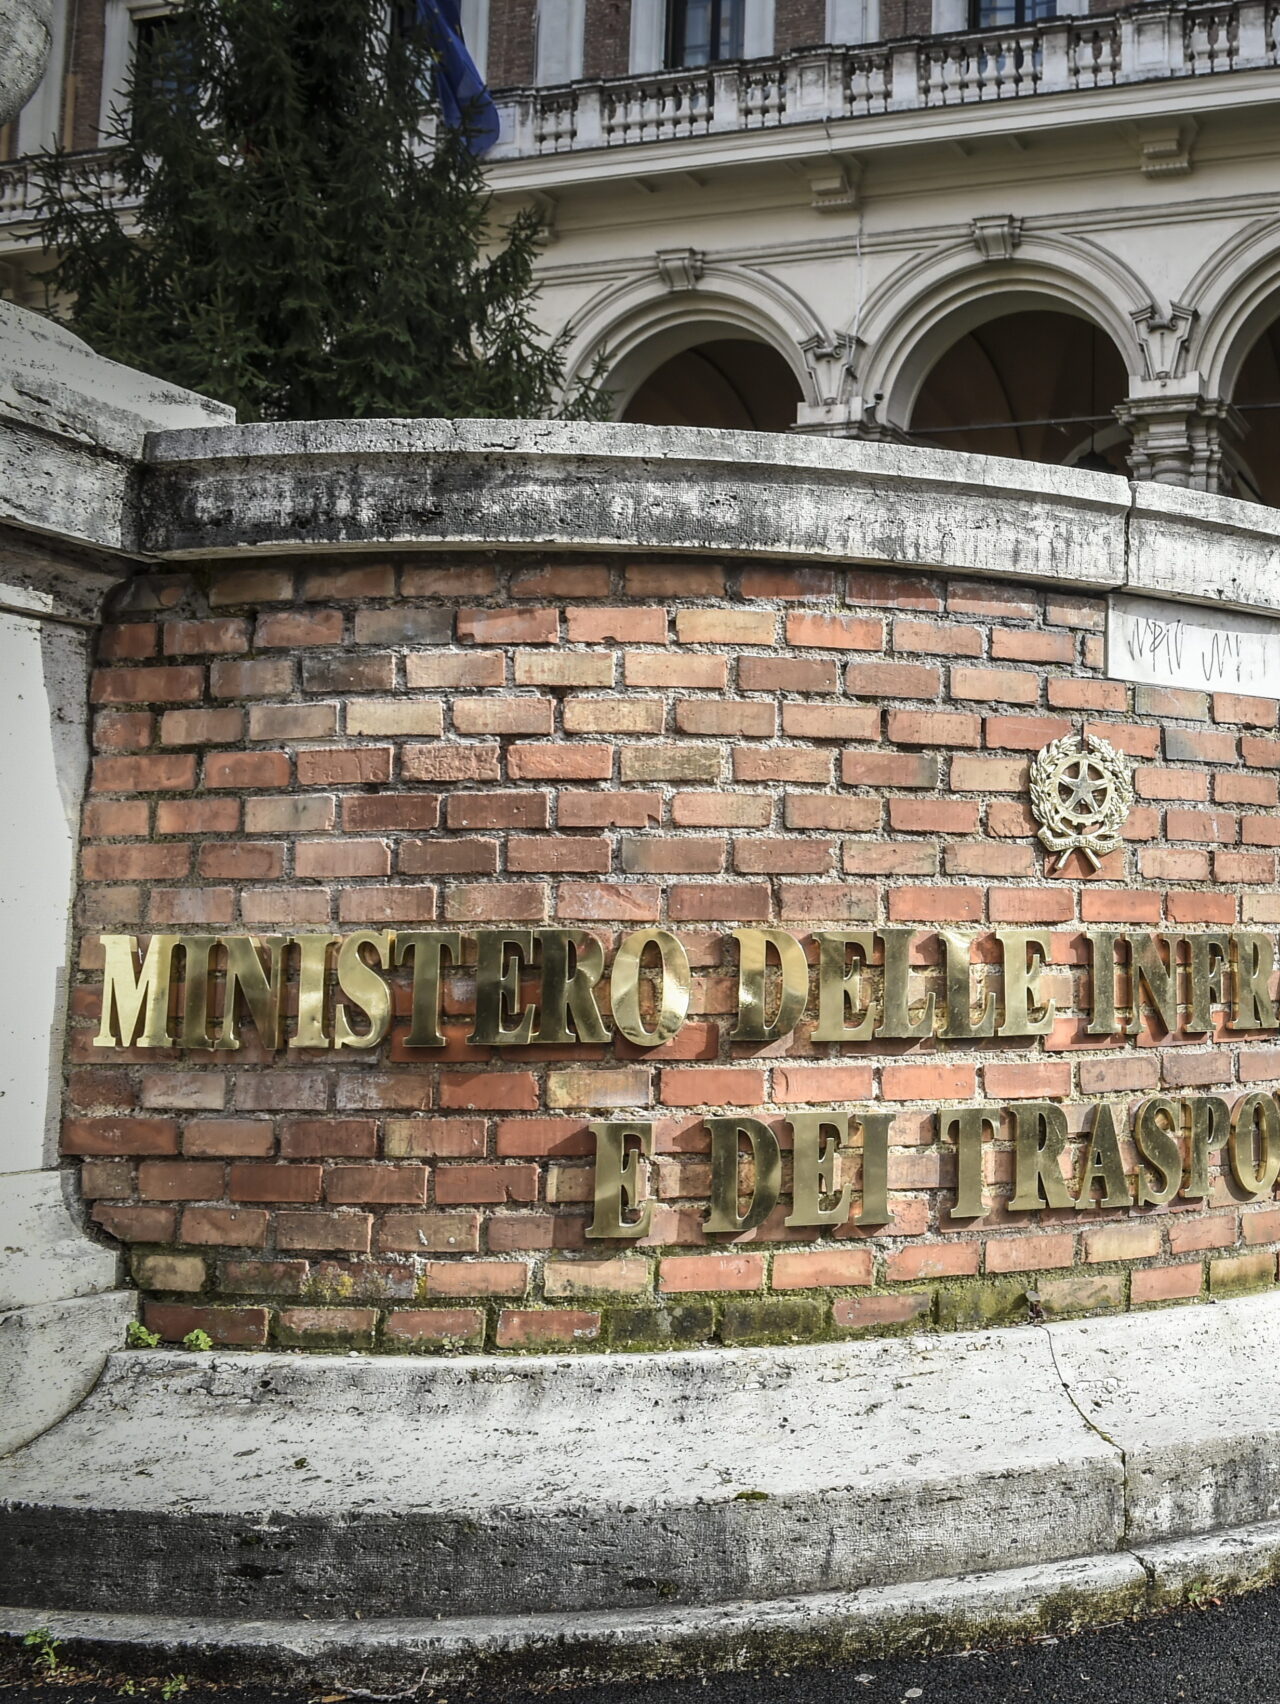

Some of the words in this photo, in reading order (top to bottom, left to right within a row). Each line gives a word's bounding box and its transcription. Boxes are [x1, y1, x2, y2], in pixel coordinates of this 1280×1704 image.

[92, 928, 692, 1050] MINISTERO
[730, 927, 1056, 1043] DELLE
[585, 1120, 656, 1239] E
[702, 1111, 896, 1234] DEI
